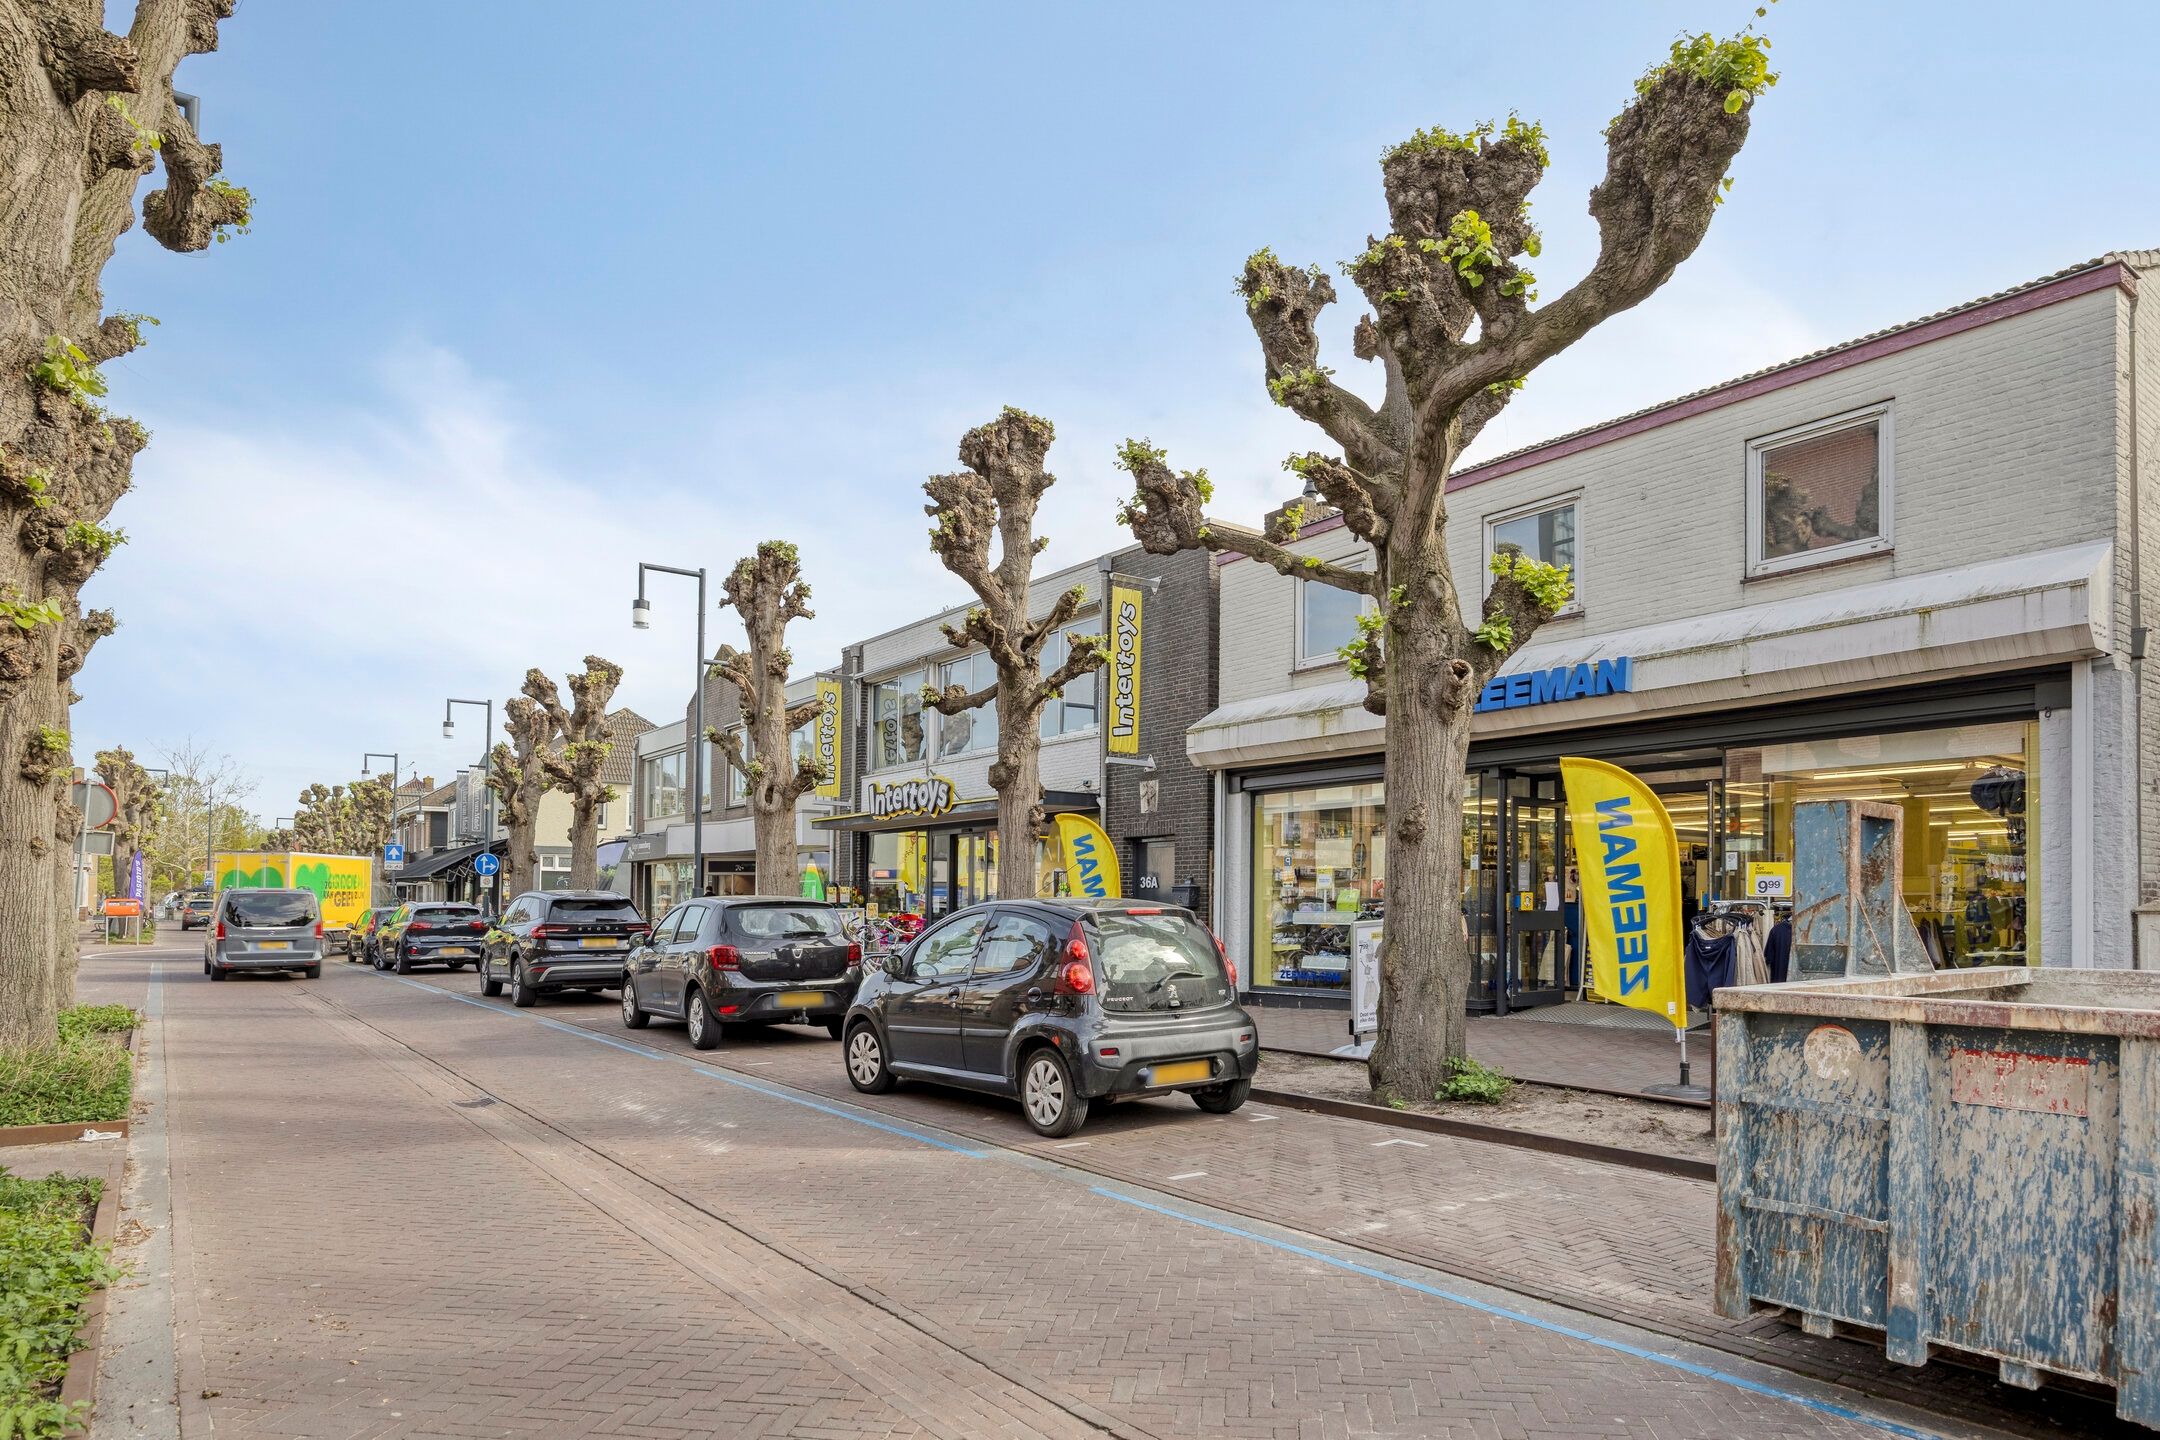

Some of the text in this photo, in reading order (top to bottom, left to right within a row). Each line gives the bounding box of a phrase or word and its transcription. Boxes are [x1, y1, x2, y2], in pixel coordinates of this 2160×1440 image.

[1113, 601, 1138, 738] Intertoys
[1474, 656, 1632, 713] EEMAN
[868, 778, 951, 816] Intertoys
[1140, 876, 1158, 889] 36A
